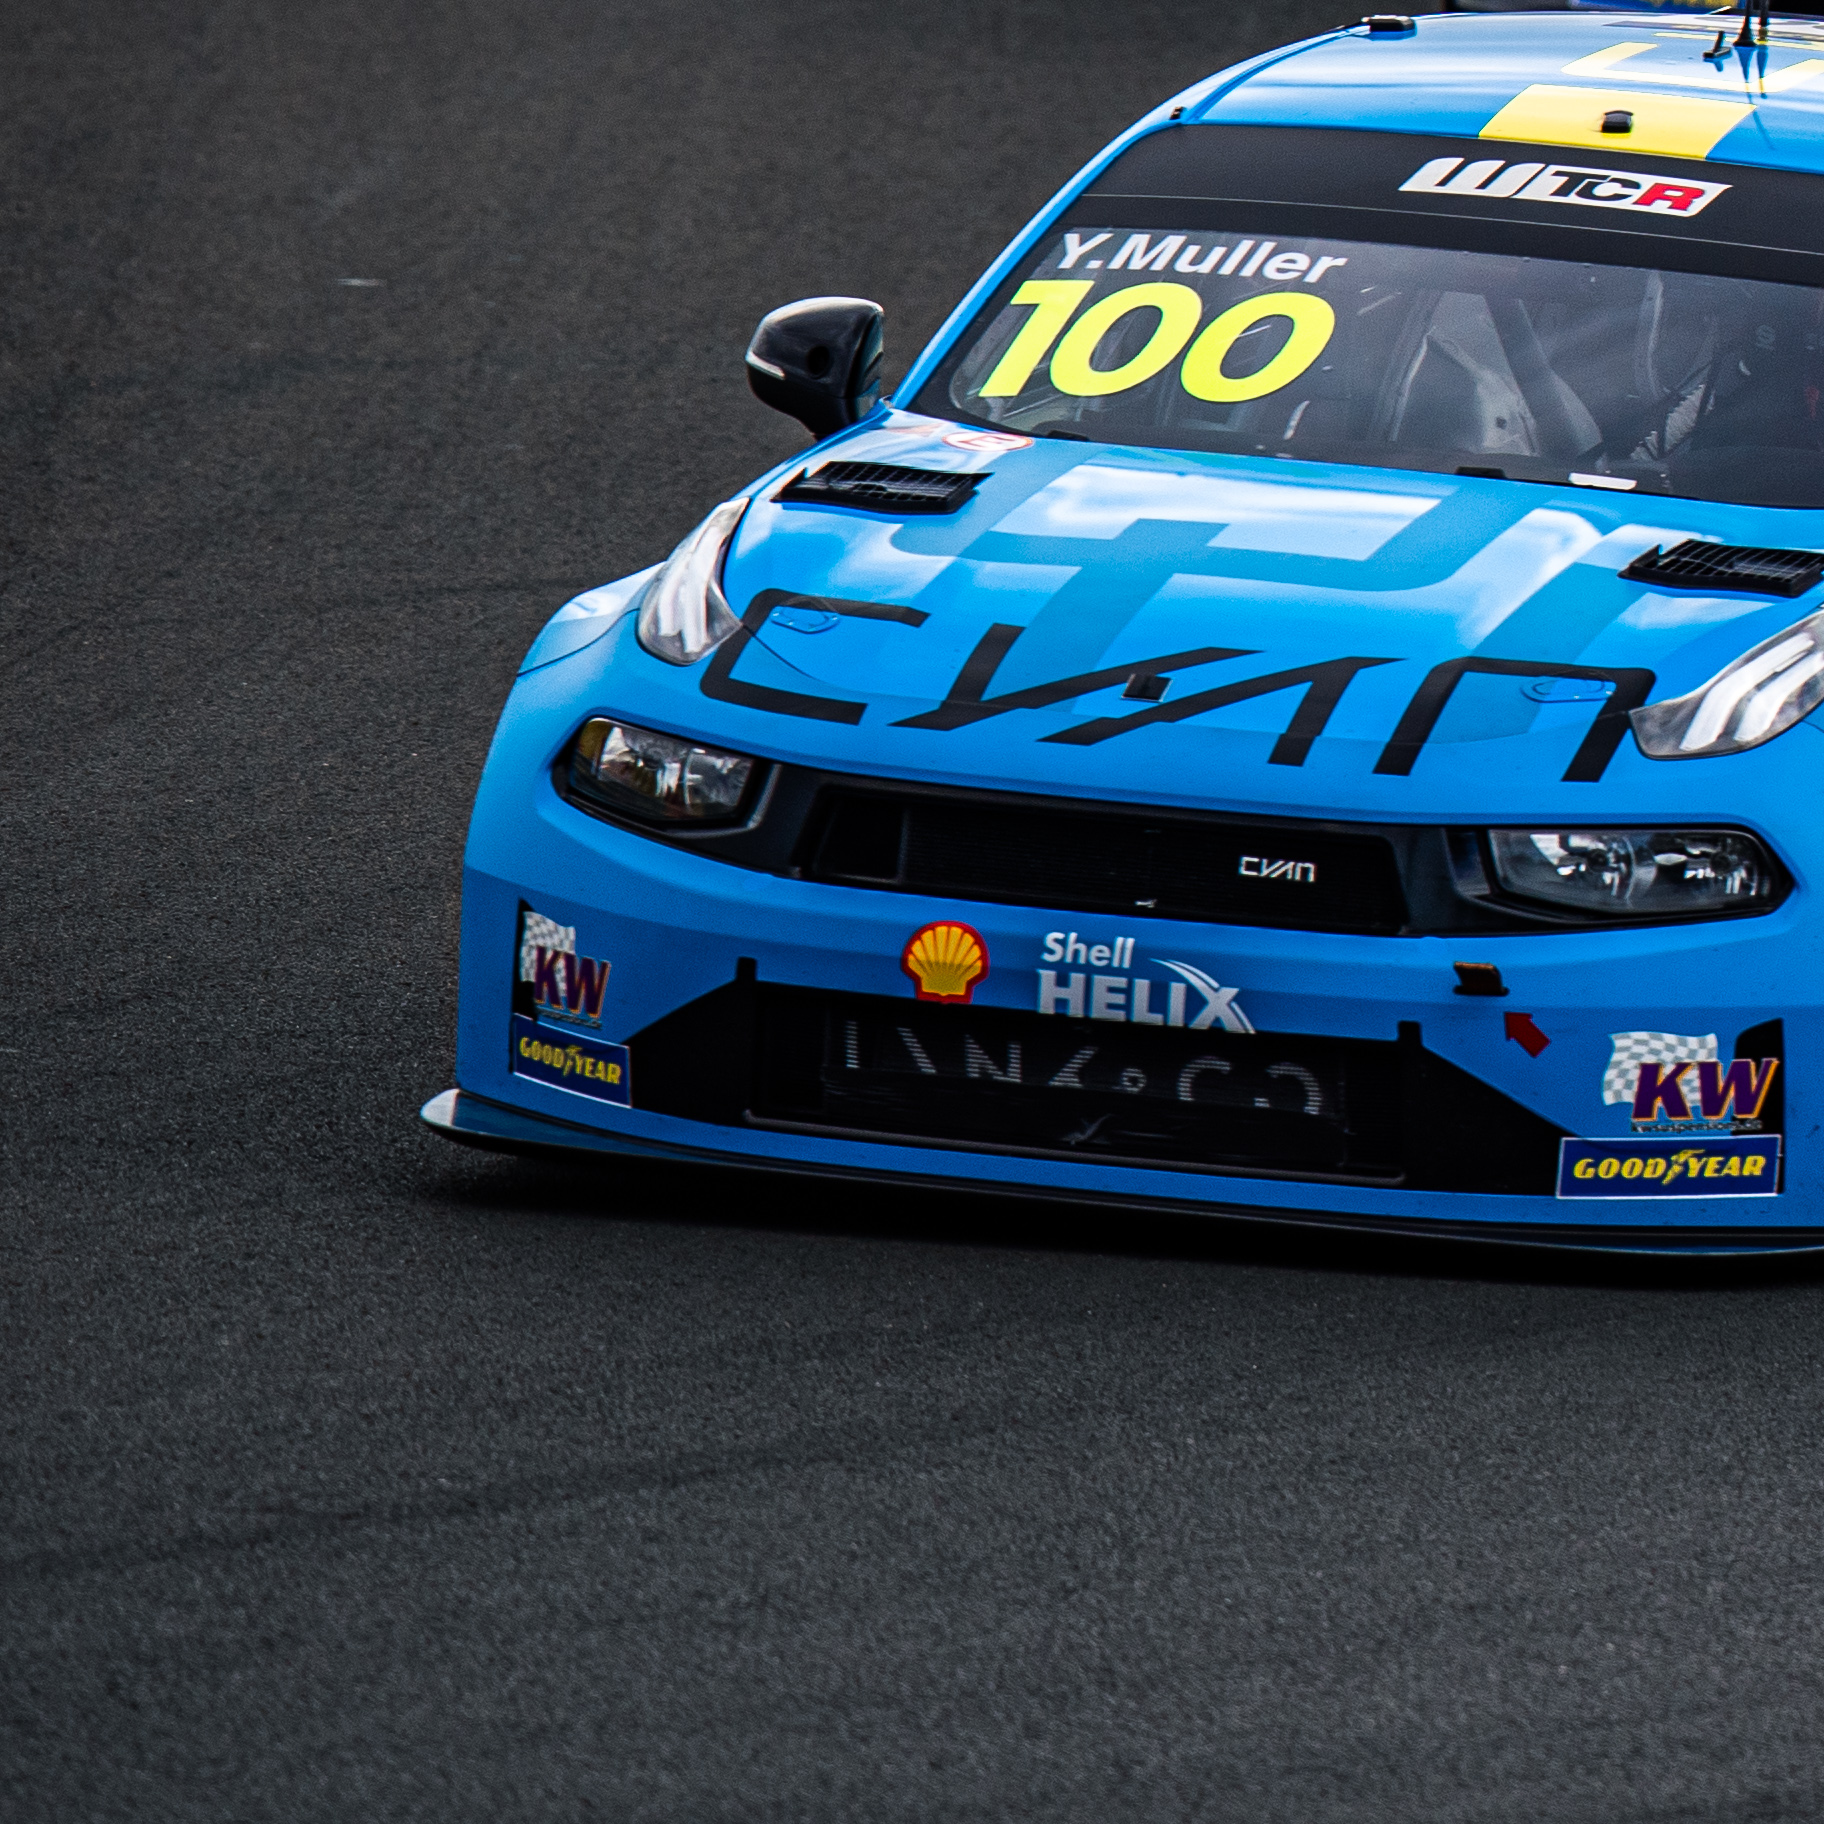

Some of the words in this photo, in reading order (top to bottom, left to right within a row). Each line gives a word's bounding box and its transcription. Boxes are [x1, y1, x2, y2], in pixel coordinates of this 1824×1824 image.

[1398, 156, 1733, 218] WTCR
[1054, 231, 1349, 285] Y.Muller
[977, 278, 1337, 405] 100
[534, 944, 612, 1018] KW
[1041, 931, 1136, 969] Shell
[1035, 959, 1257, 1035] HELIX
[519, 1034, 623, 1086] GOODYEAR
[1630, 1057, 1782, 1124] KW
[1572, 1148, 1768, 1186] GOODYEAR
